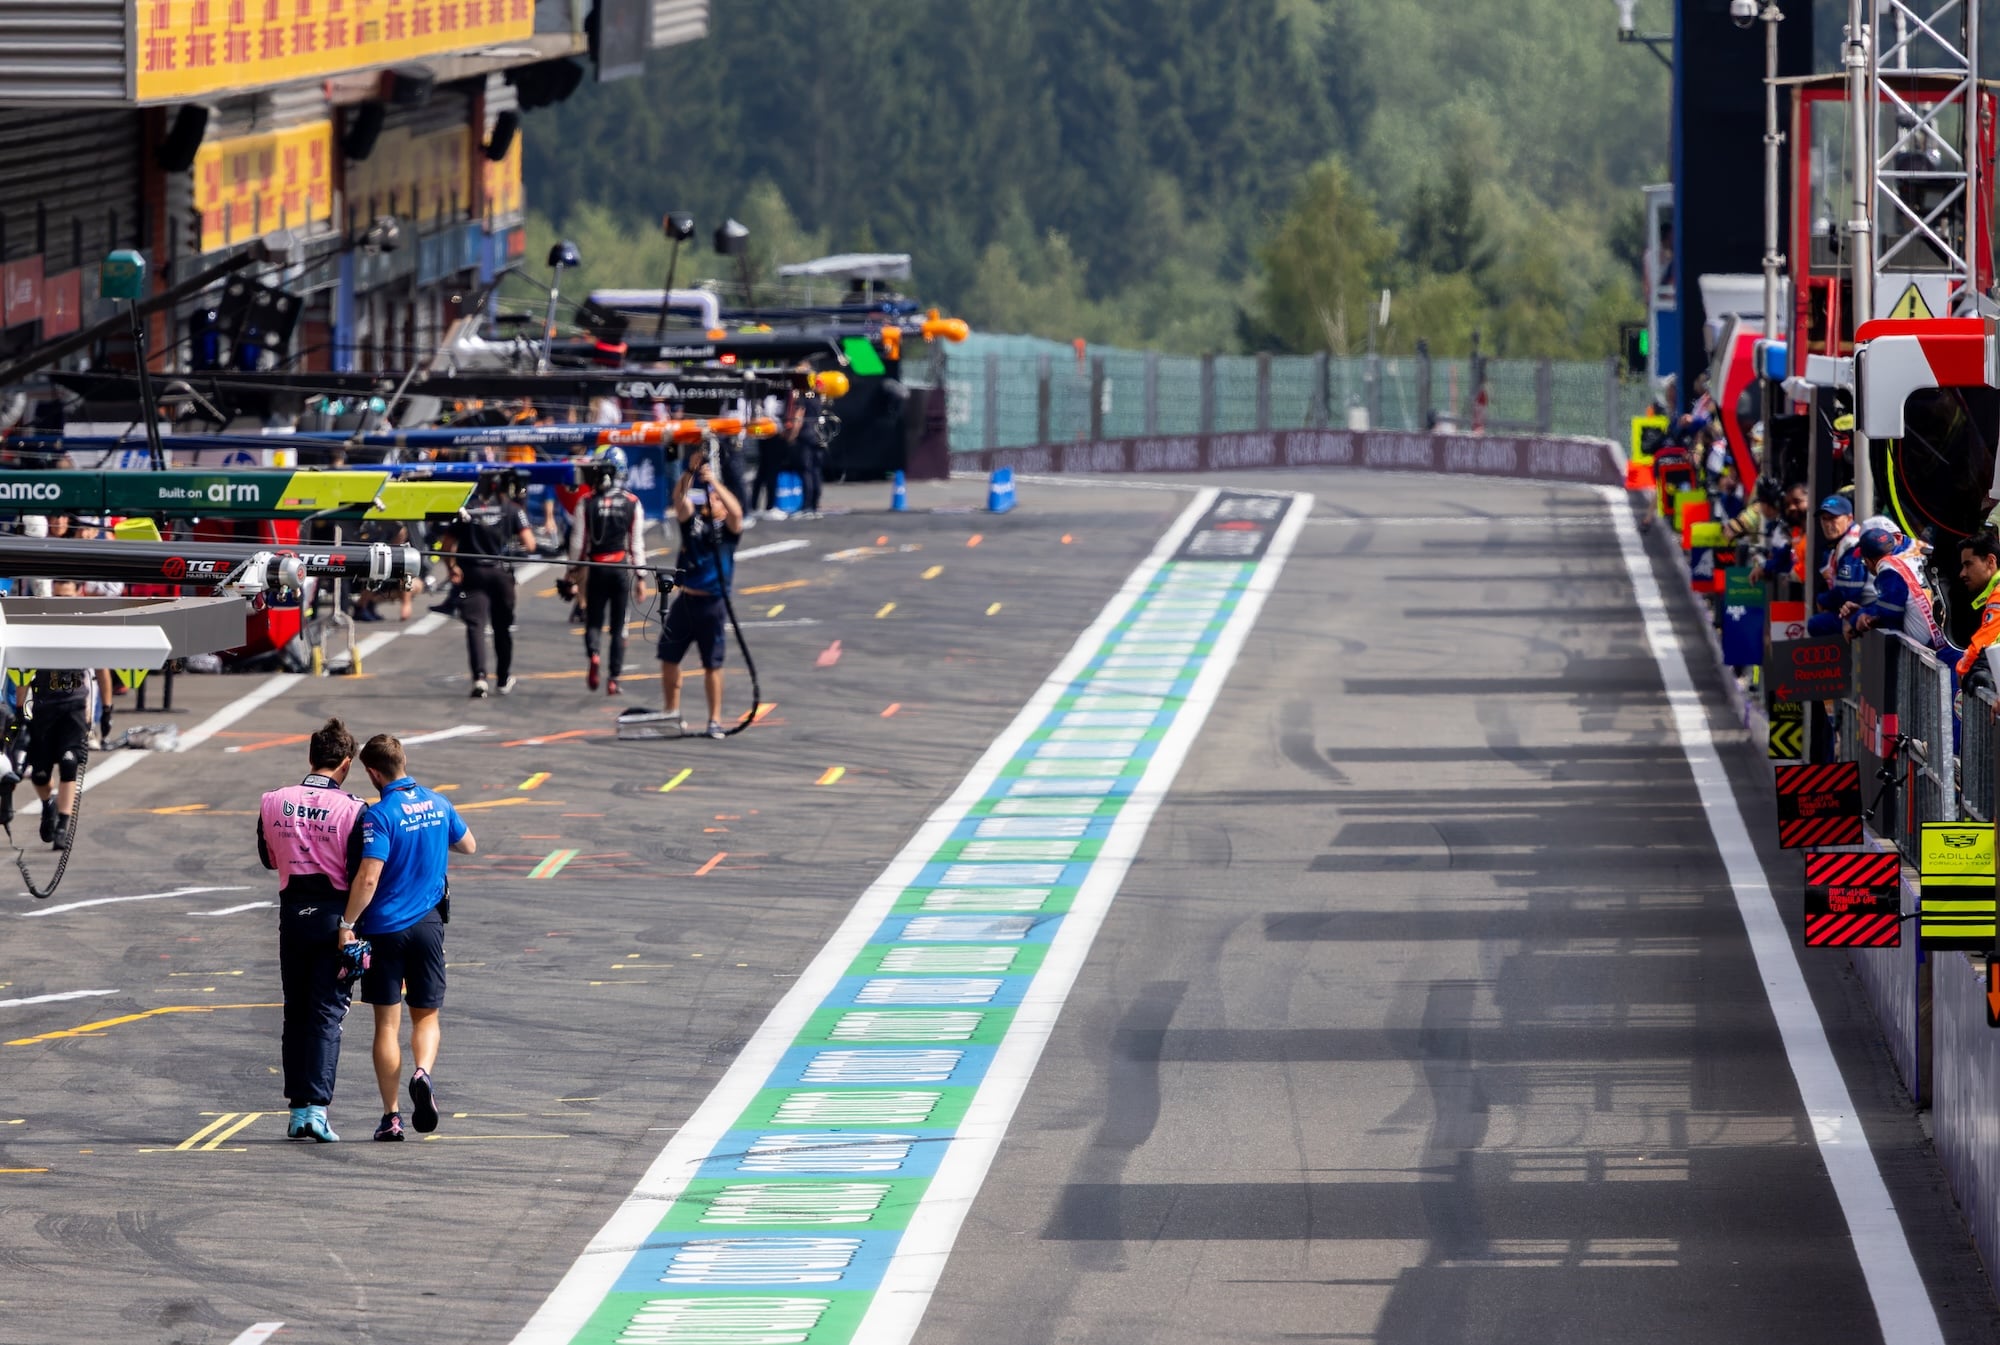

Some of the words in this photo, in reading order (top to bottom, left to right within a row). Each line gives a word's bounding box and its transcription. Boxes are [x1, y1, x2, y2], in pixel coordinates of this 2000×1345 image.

[159, 487, 185, 499] Built
[188, 489, 203, 499] on
[207, 483, 260, 502] arm
[299, 553, 346, 566] TGR
[186, 561, 231, 573] TGR
[1794, 667, 1842, 681] Revolut
[297, 805, 330, 821] BWT
[413, 800, 434, 814] BWT
[400, 811, 445, 827] ALPINE
[273, 820, 338, 834] ALPINE
[1928, 852, 1992, 860] CADILLAC
